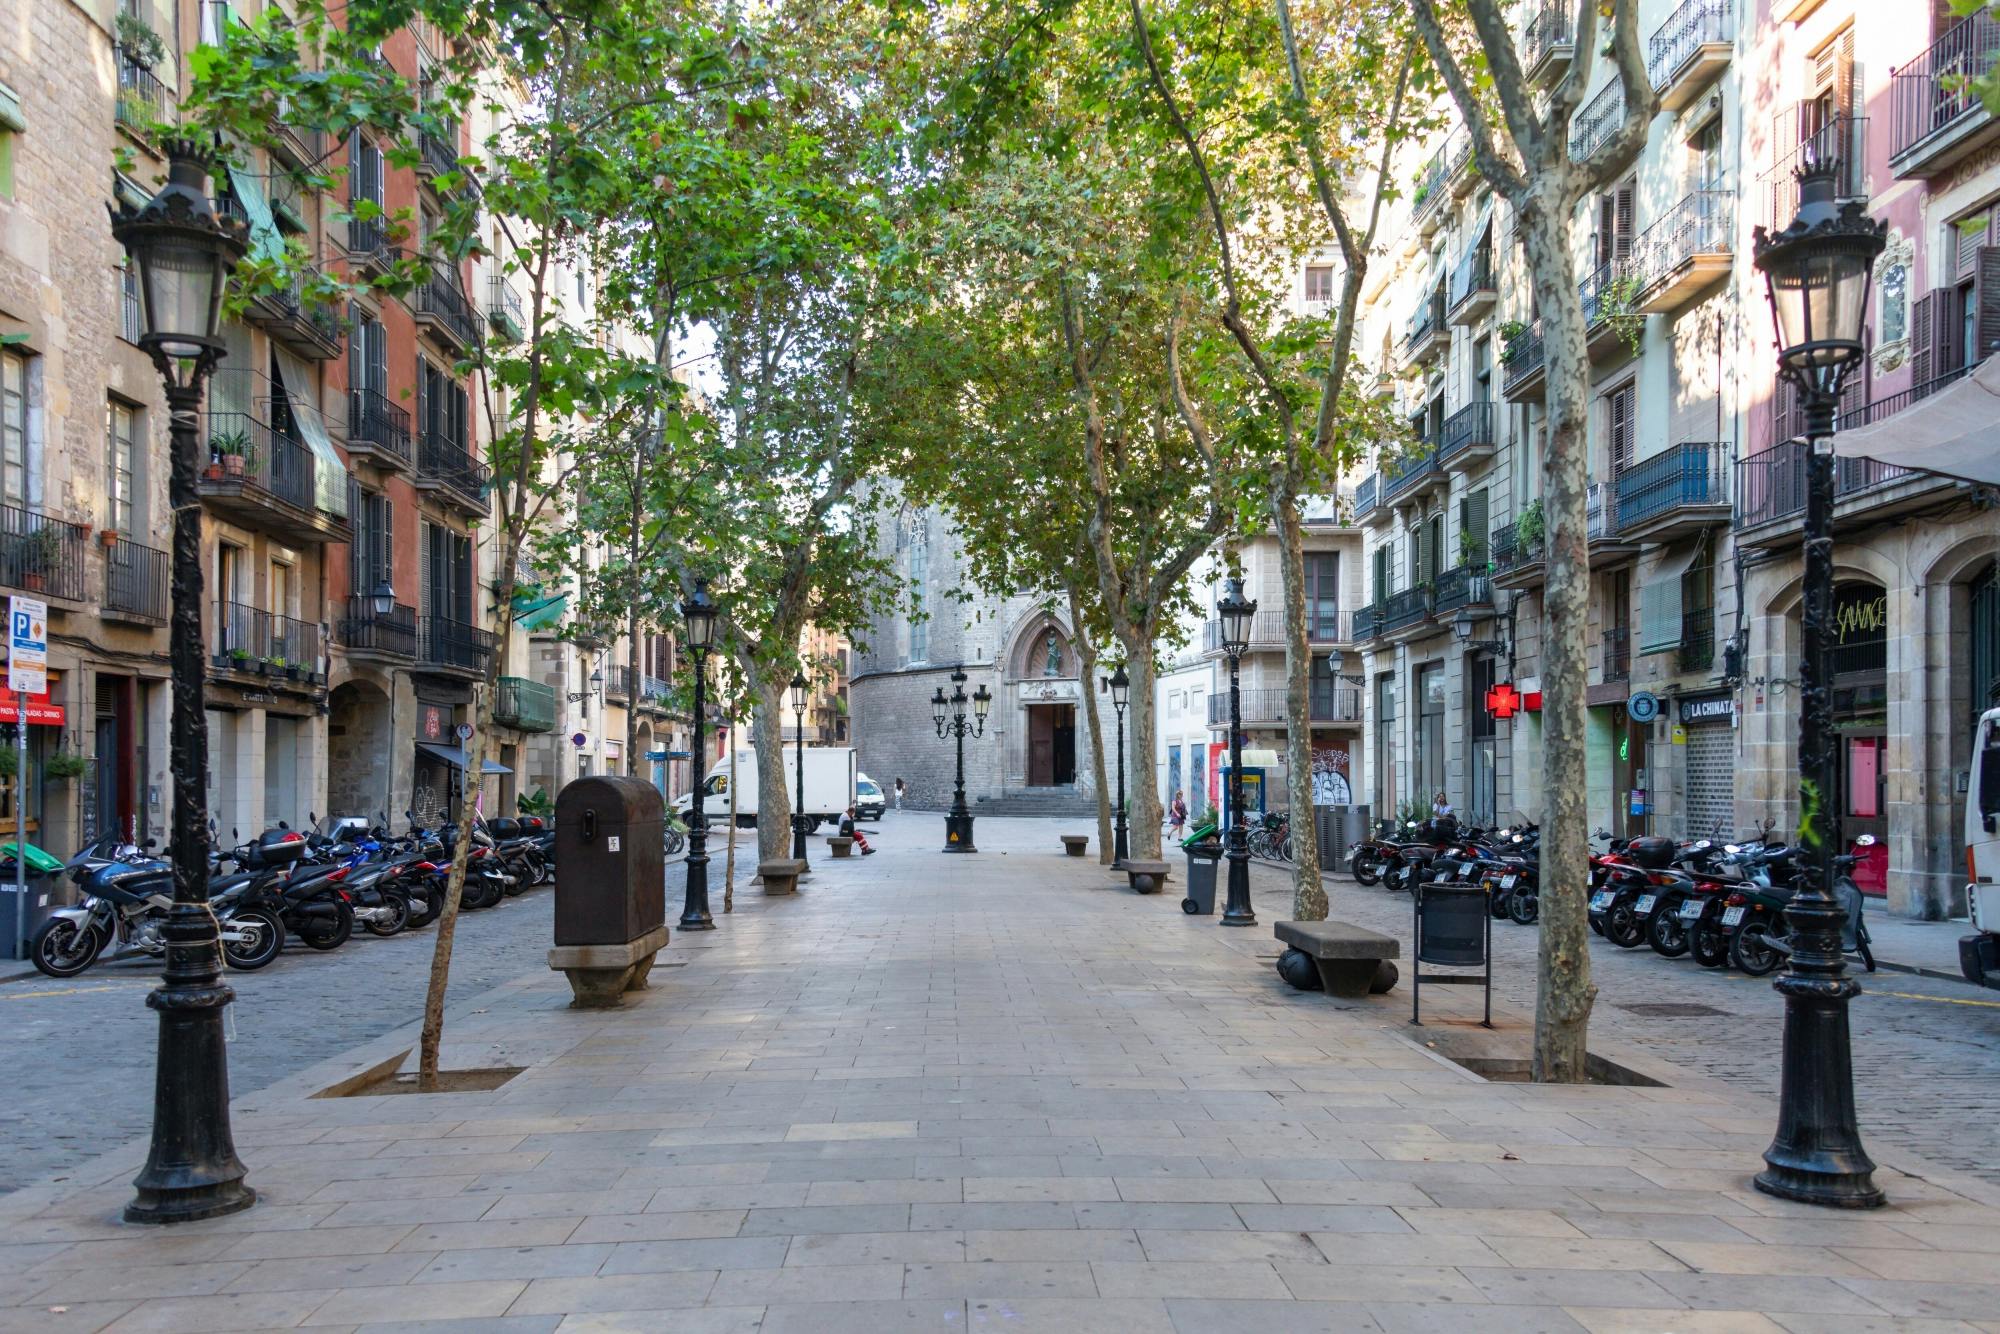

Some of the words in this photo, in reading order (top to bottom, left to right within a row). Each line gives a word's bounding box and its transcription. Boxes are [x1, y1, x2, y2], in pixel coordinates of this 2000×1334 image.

[17, 614, 28, 636] P
[0, 707, 15, 715] PASTA
[1691, 703, 1702, 717] LA
[1702, 700, 1736, 716] CHINATA
